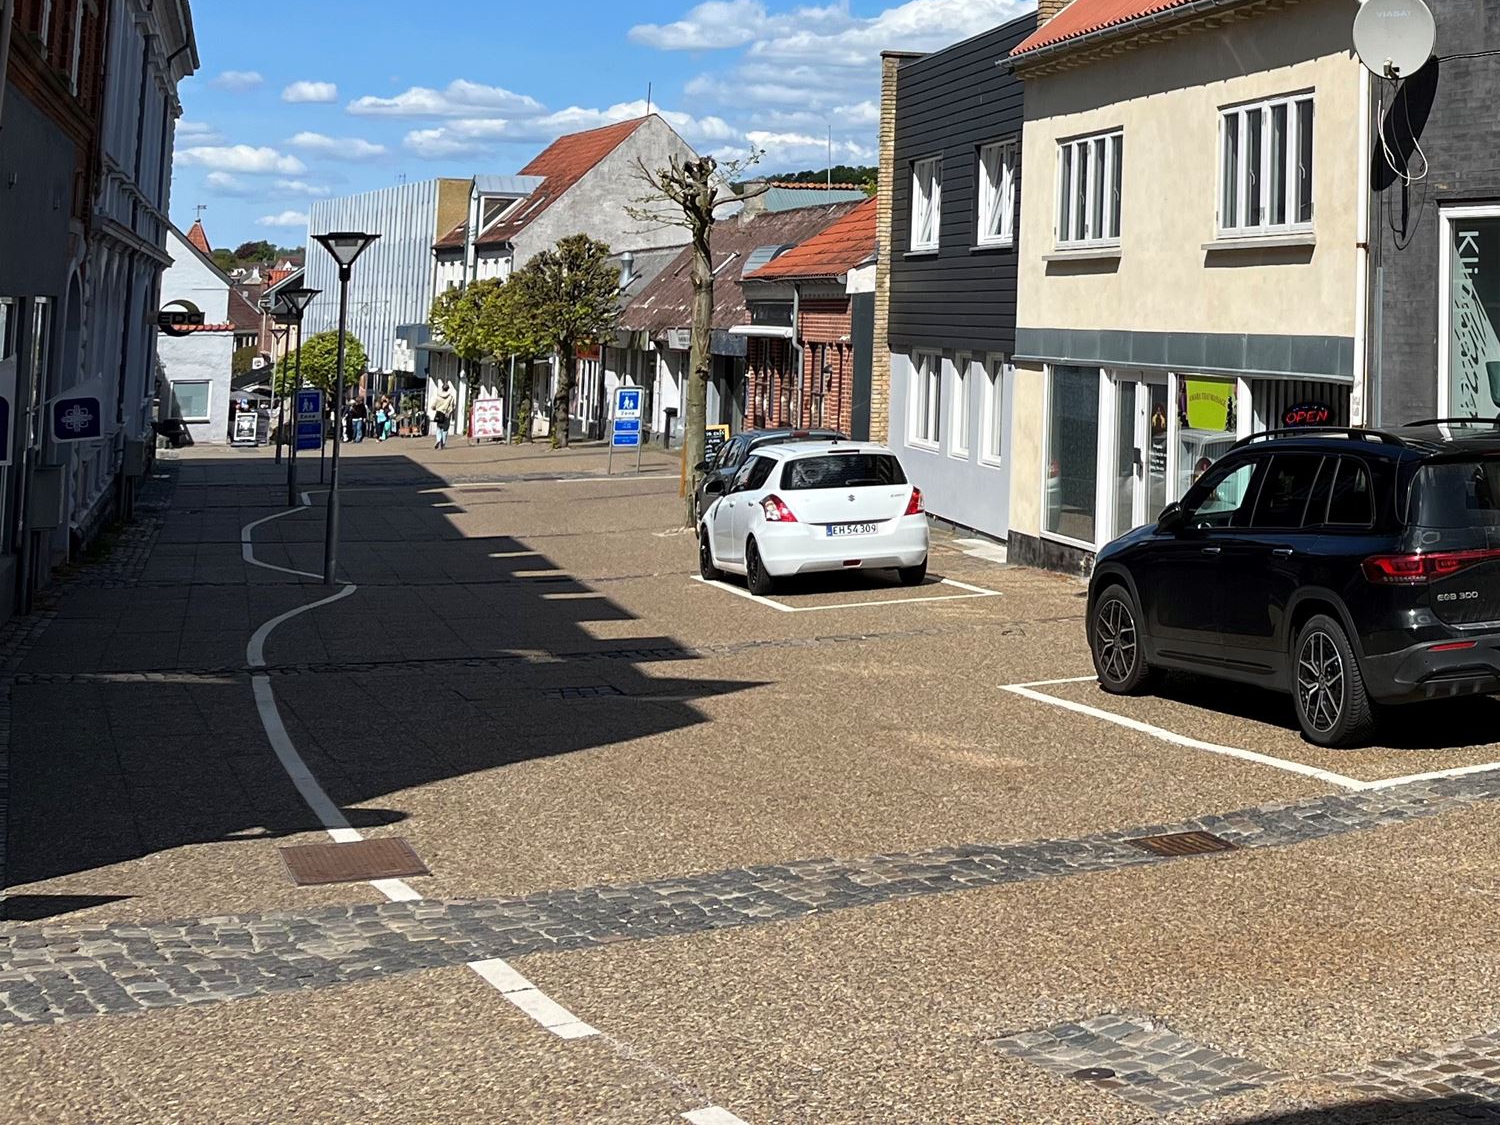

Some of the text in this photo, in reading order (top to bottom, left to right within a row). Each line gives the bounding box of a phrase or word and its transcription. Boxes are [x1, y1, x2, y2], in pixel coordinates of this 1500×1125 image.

[158, 313, 202, 324] EDC
[1285, 409, 1329, 425] OPEN
[833, 523, 877, 535] EH 54 309
[1459, 591, 1479, 600] 300
